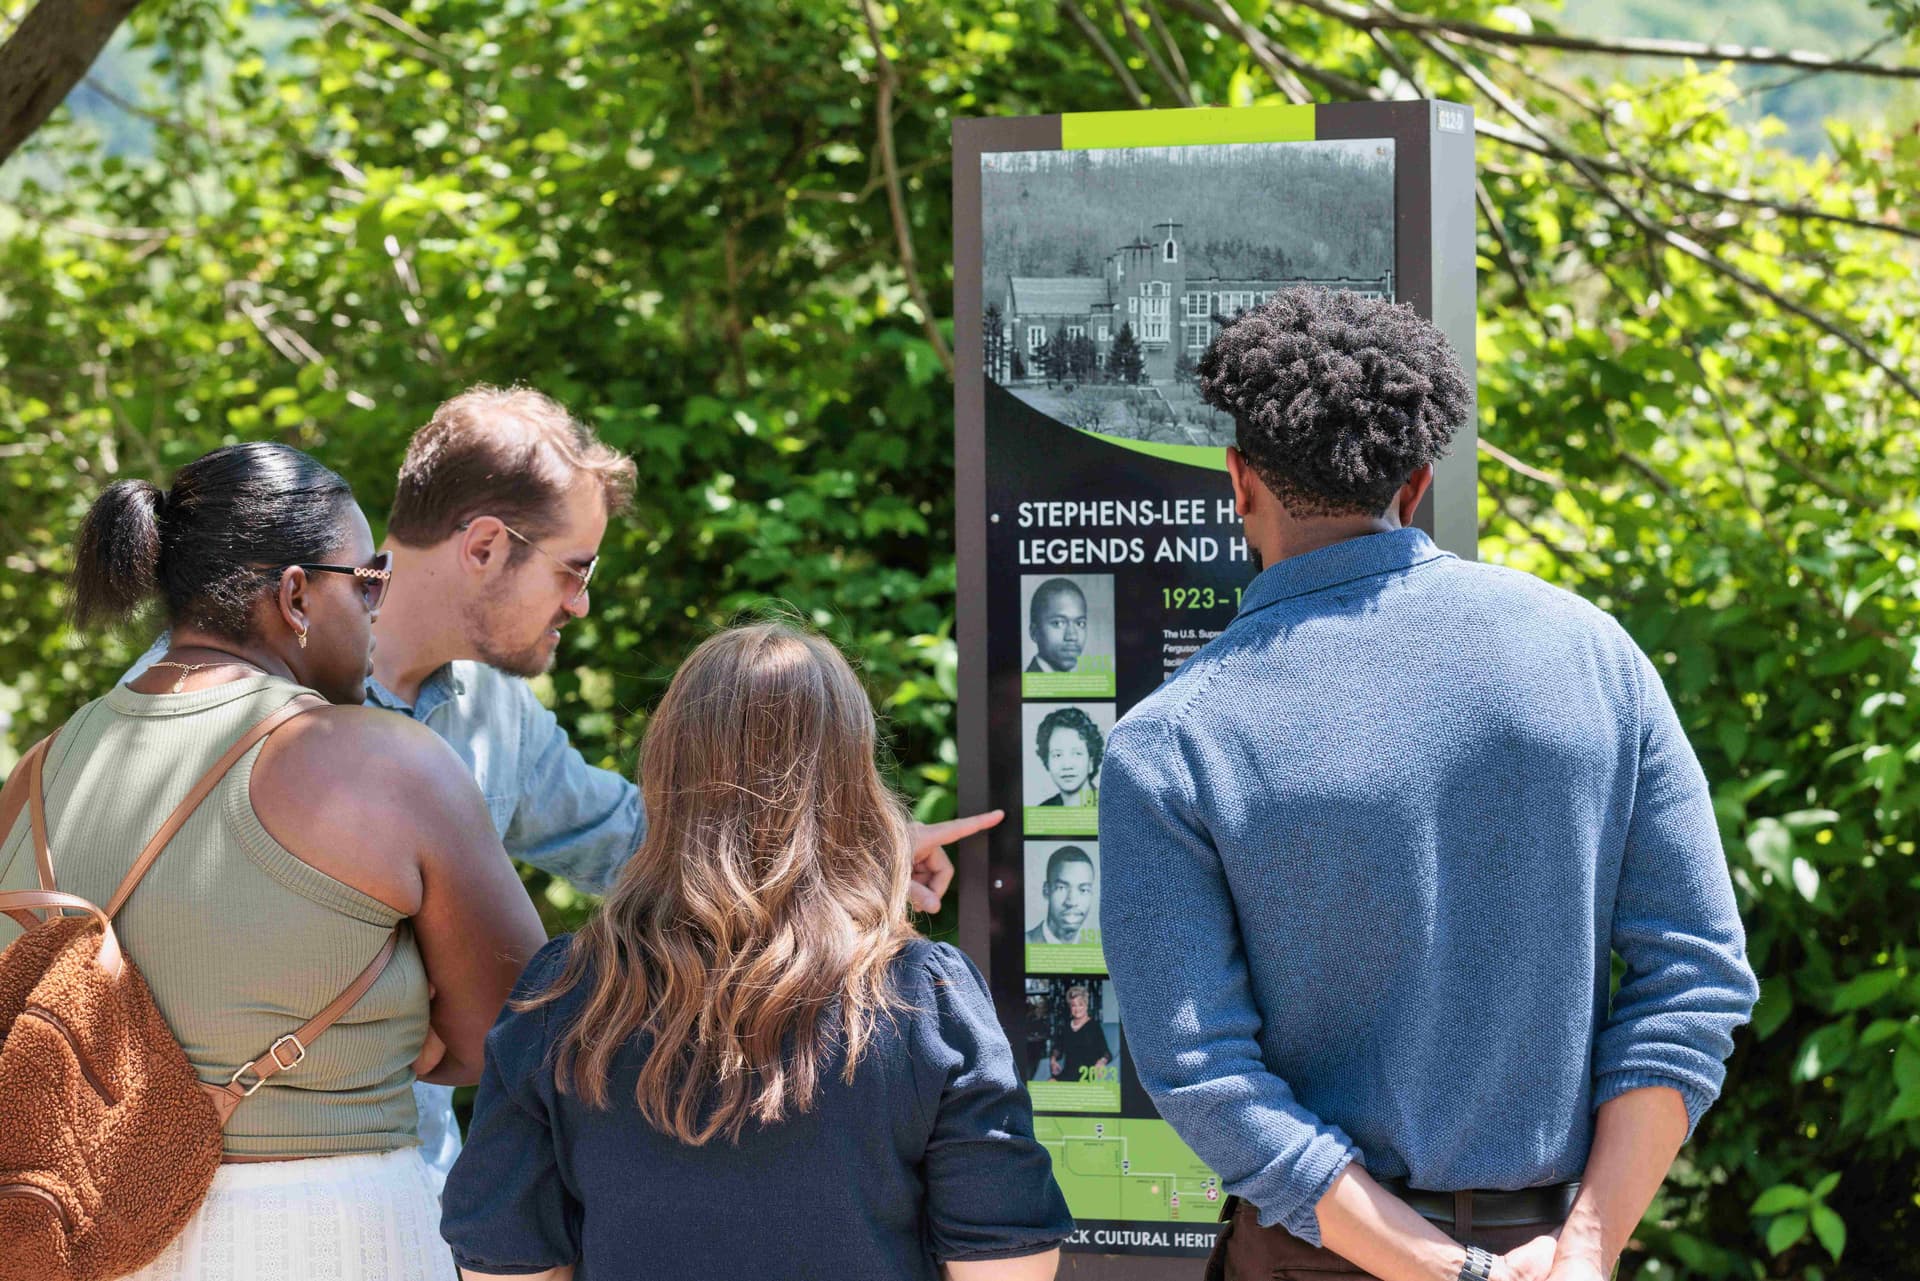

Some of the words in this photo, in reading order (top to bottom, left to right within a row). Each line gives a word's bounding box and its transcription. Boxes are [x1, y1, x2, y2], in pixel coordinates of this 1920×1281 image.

[1018, 499, 1206, 528] STEPHENS-LEE
[1217, 499, 1243, 524] H.
[1018, 537, 1145, 565] LEGENDS
[1154, 536, 1218, 563] AND
[1230, 536, 1248, 562] H
[1162, 587, 1243, 610] 1923–1
[1163, 629, 1179, 639] The
[1179, 629, 1197, 639] U.S.
[1064, 1230, 1091, 1244] CK
[1094, 1230, 1170, 1247] CULTURAL
[1174, 1232, 1217, 1248] HERIT
